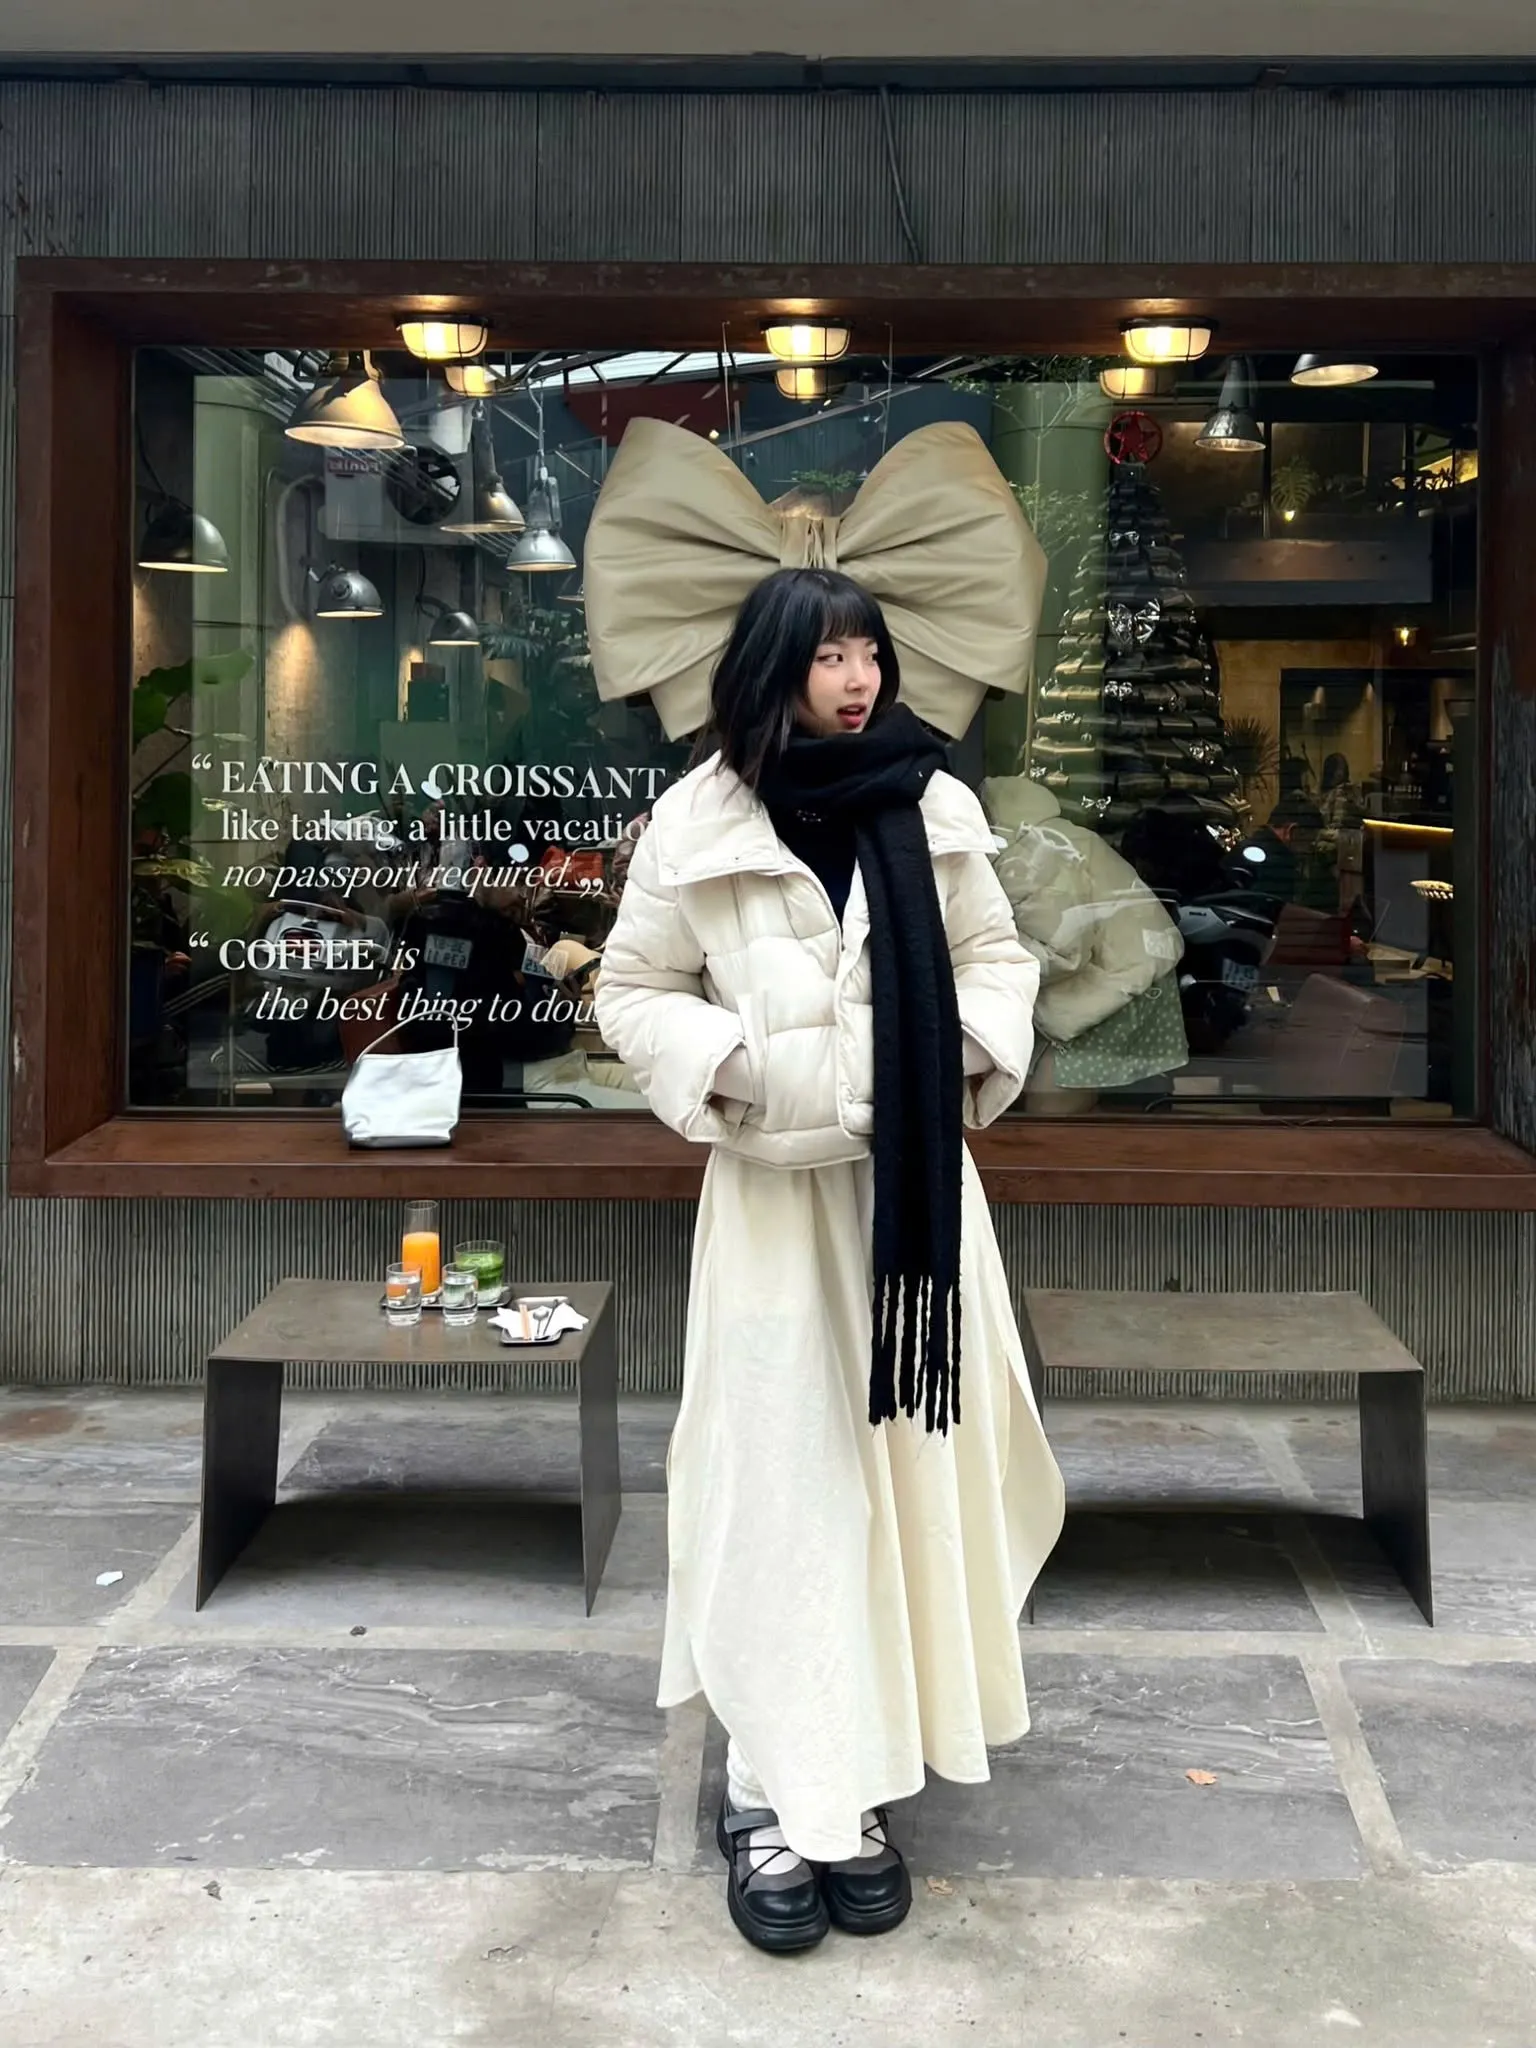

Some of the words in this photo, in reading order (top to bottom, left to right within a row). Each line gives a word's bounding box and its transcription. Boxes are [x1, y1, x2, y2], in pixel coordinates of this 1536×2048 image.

[388, 763, 416, 795] A
[428, 763, 666, 799] CROISSANT
[221, 808, 279, 841] like
[292, 810, 398, 851] taking
[408, 821, 428, 841] a
[439, 809, 512, 842] little
[523, 813, 652, 842] vacatio
[221, 865, 266, 887] no
[268, 861, 420, 898] passport
[391, 940, 420, 970] is
[255, 987, 308, 1020] the
[316, 987, 390, 1020] best
[396, 987, 482, 1031] thing
[487, 993, 522, 1022] to
[531, 990, 599, 1023] dou
